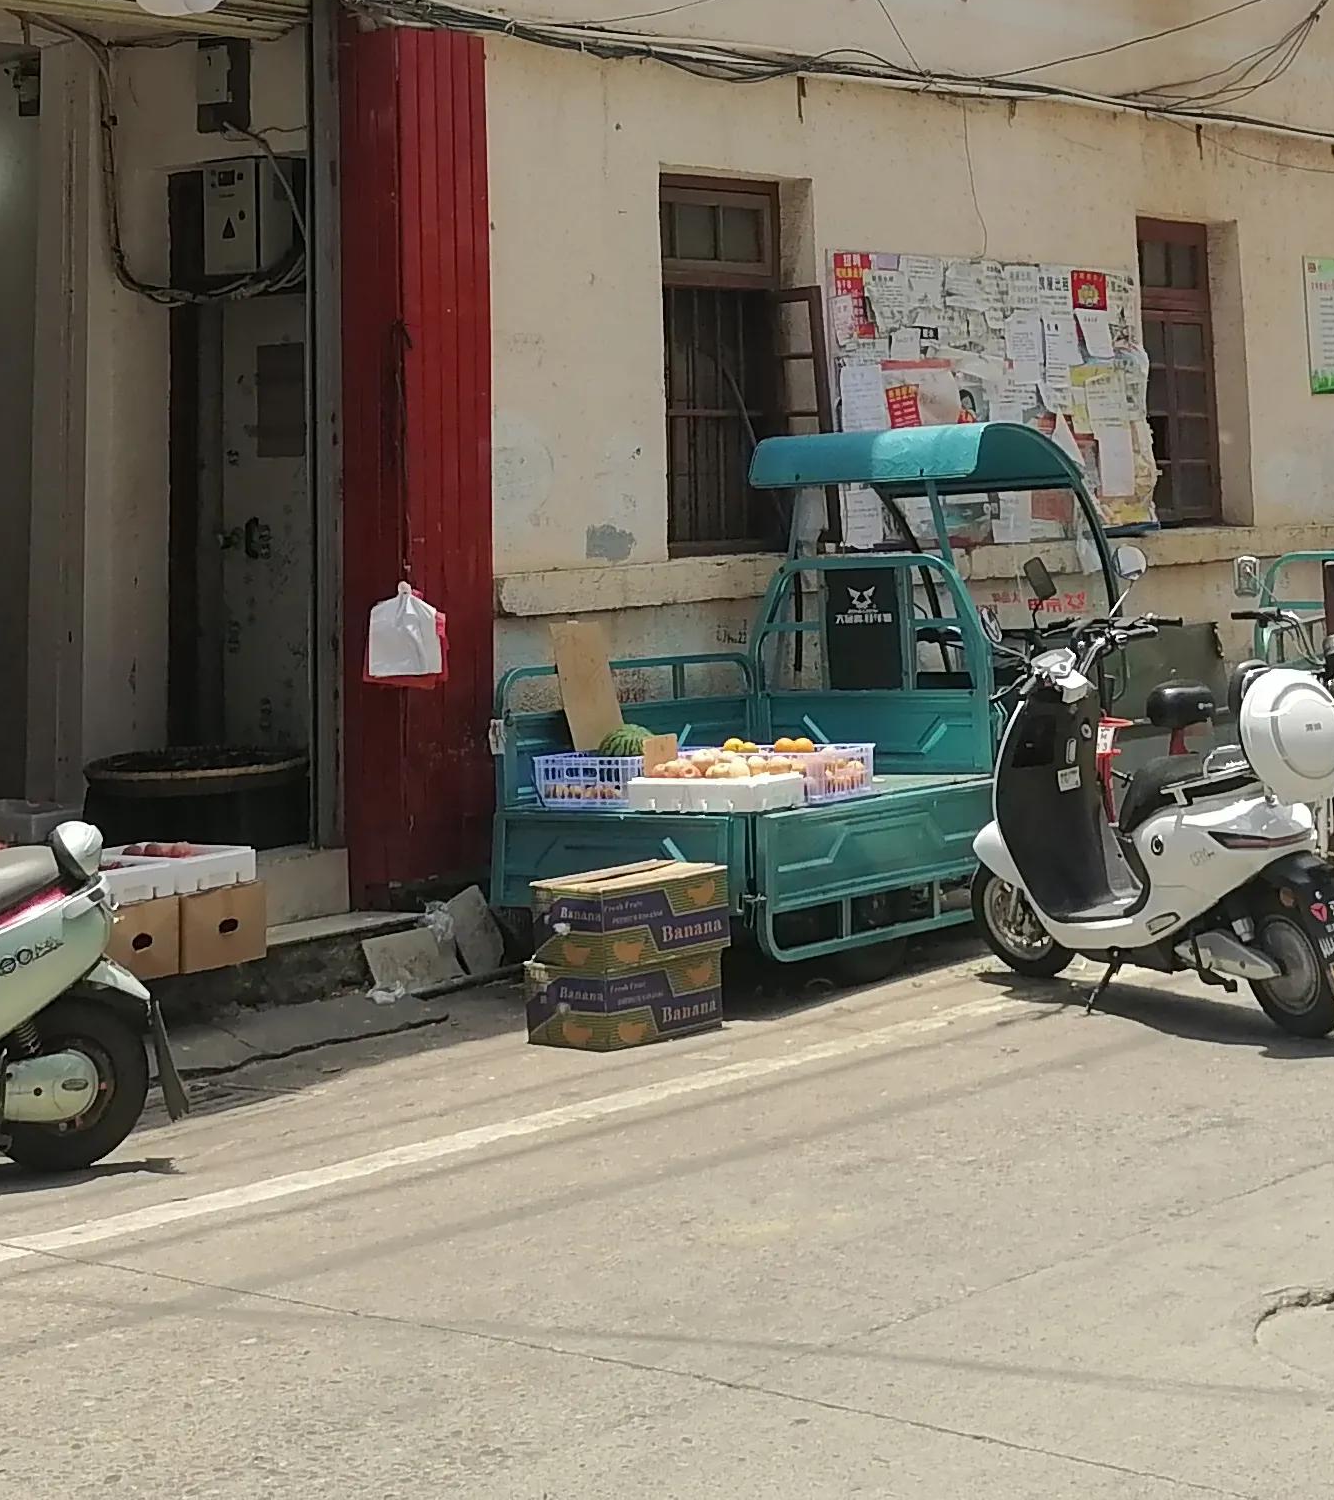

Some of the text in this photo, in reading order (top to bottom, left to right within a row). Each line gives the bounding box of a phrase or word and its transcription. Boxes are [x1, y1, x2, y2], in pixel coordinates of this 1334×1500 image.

[559, 906, 602, 923] Banana
[661, 917, 723, 943] Banana
[559, 985, 604, 1003] Banana
[661, 997, 718, 1024] Banana
